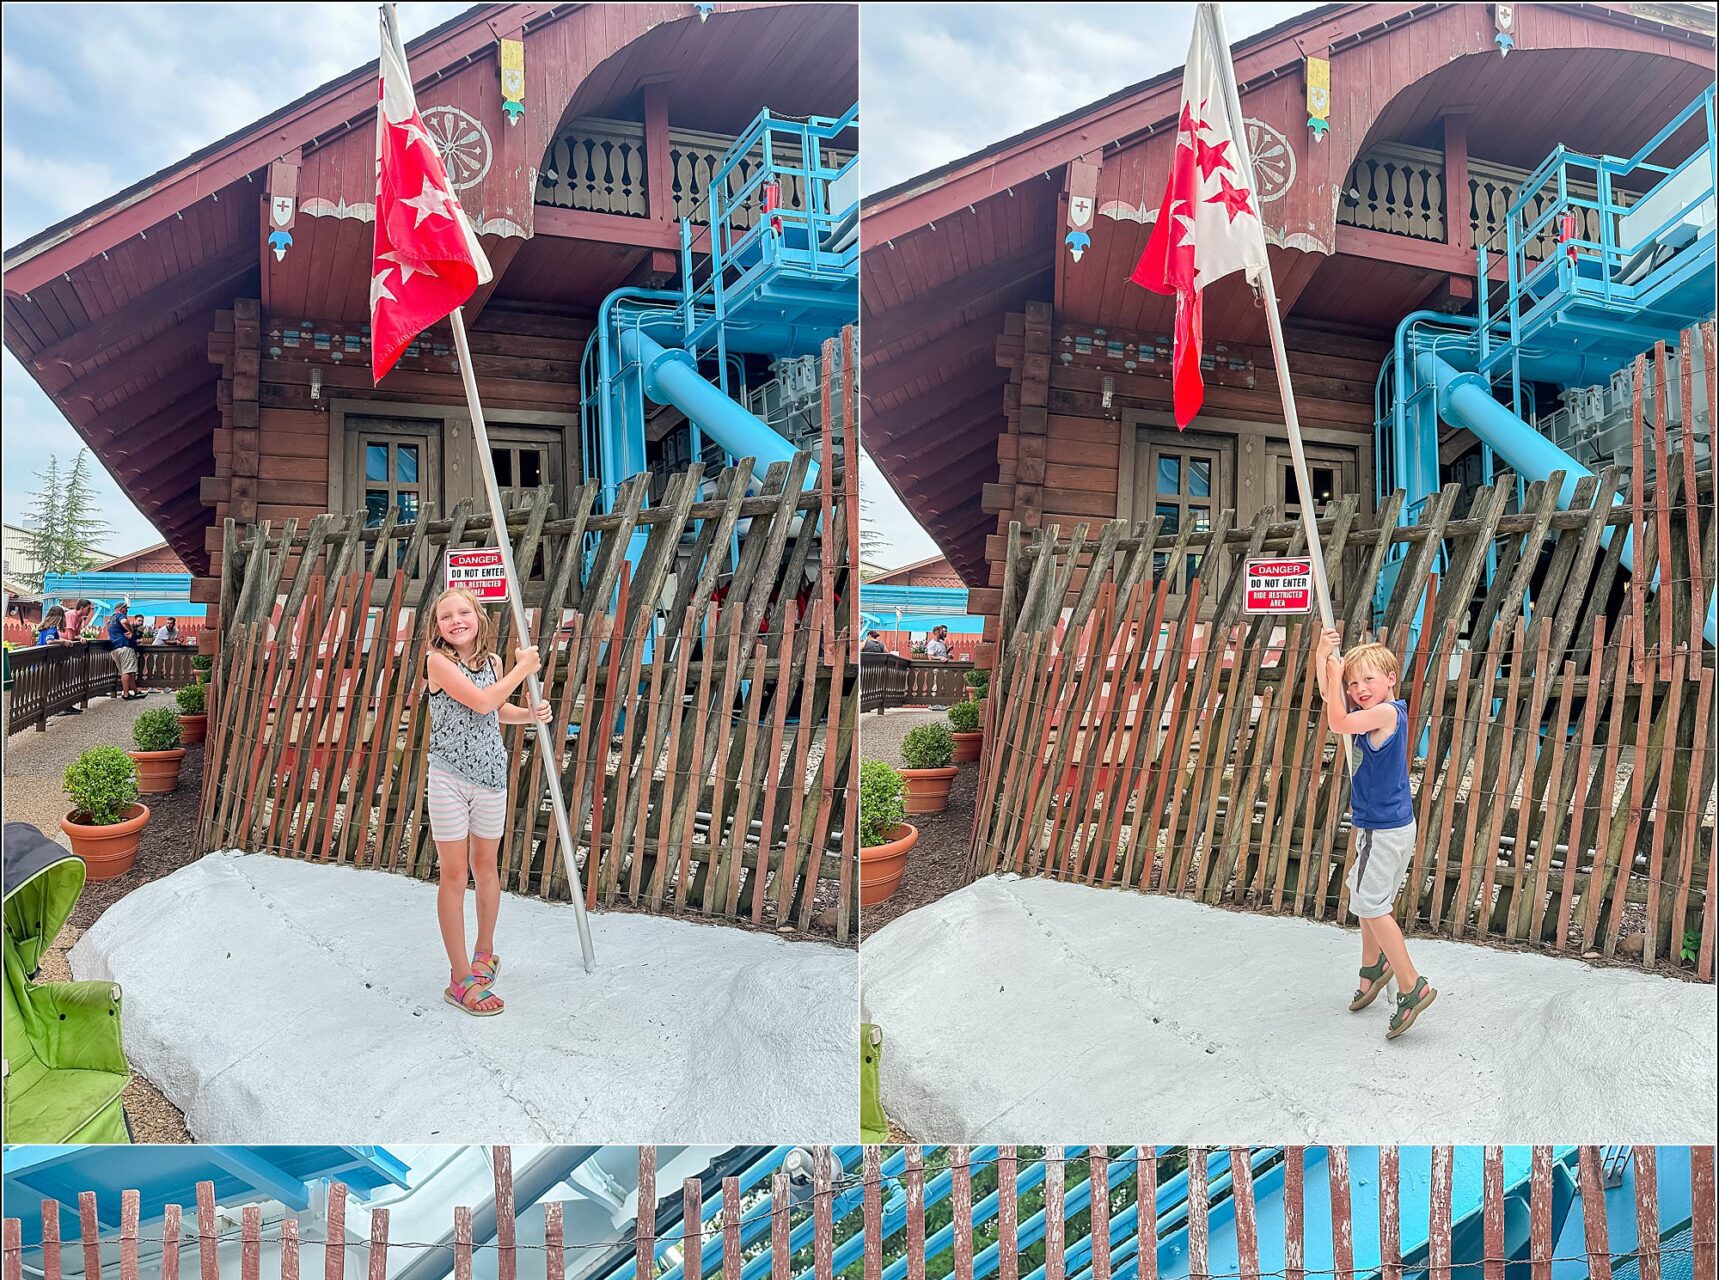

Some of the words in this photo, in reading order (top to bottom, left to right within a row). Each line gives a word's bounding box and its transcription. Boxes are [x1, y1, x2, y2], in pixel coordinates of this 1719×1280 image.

[458, 556, 498, 564] DANGER
[451, 569, 461, 578] DO
[464, 569, 479, 577] NOT
[482, 568, 504, 577] ENTER
[1258, 565, 1300, 574] DANGER
[468, 580, 501, 588] RESTRICTED
[1251, 579, 1261, 588] DO
[1264, 579, 1280, 587] NOT
[1283, 578, 1307, 587] ENTER
[1253, 591, 1266, 599] RIDE
[1268, 591, 1303, 599] RESTRICTED
[1270, 599, 1286, 607] AREA
